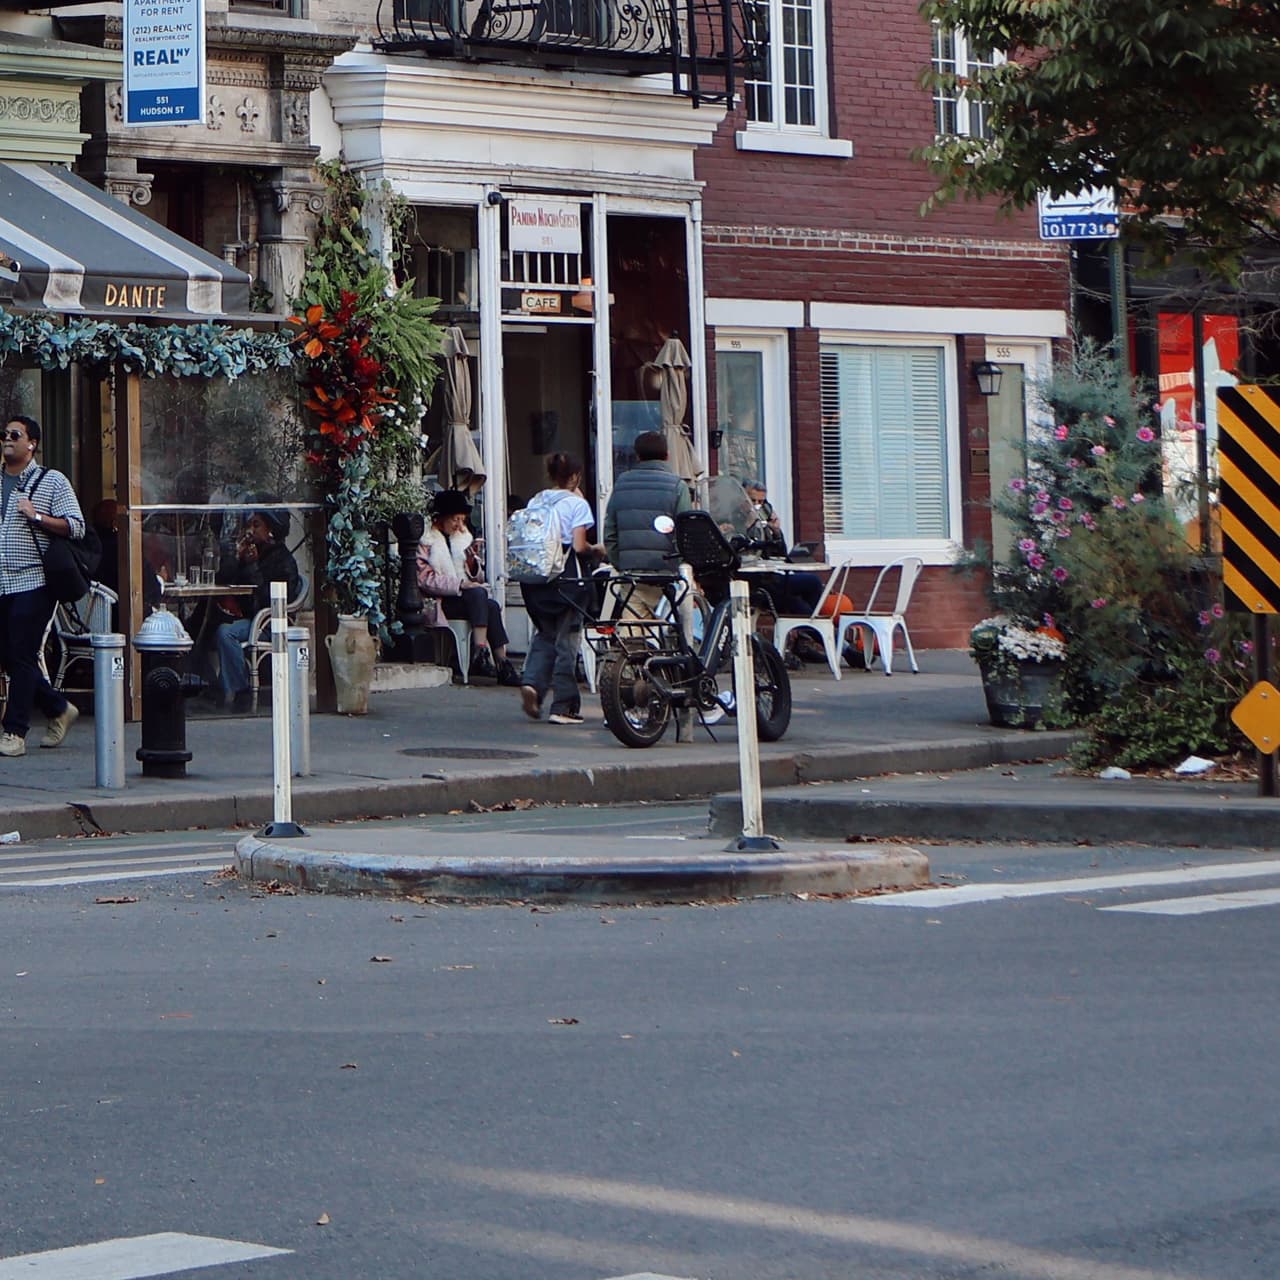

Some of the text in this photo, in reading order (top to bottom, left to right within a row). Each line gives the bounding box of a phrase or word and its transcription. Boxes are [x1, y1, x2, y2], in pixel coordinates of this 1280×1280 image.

[140, 6, 184, 17] FOR RENT
[132, 23, 193, 36] (212) REAL-NYC
[156, 96, 169, 104] 551
[140, 105, 185, 116] HUDSON ST
[1043, 222, 1098, 236] 101773
[105, 283, 166, 309] DANTE
[526, 296, 556, 308] CAFE
